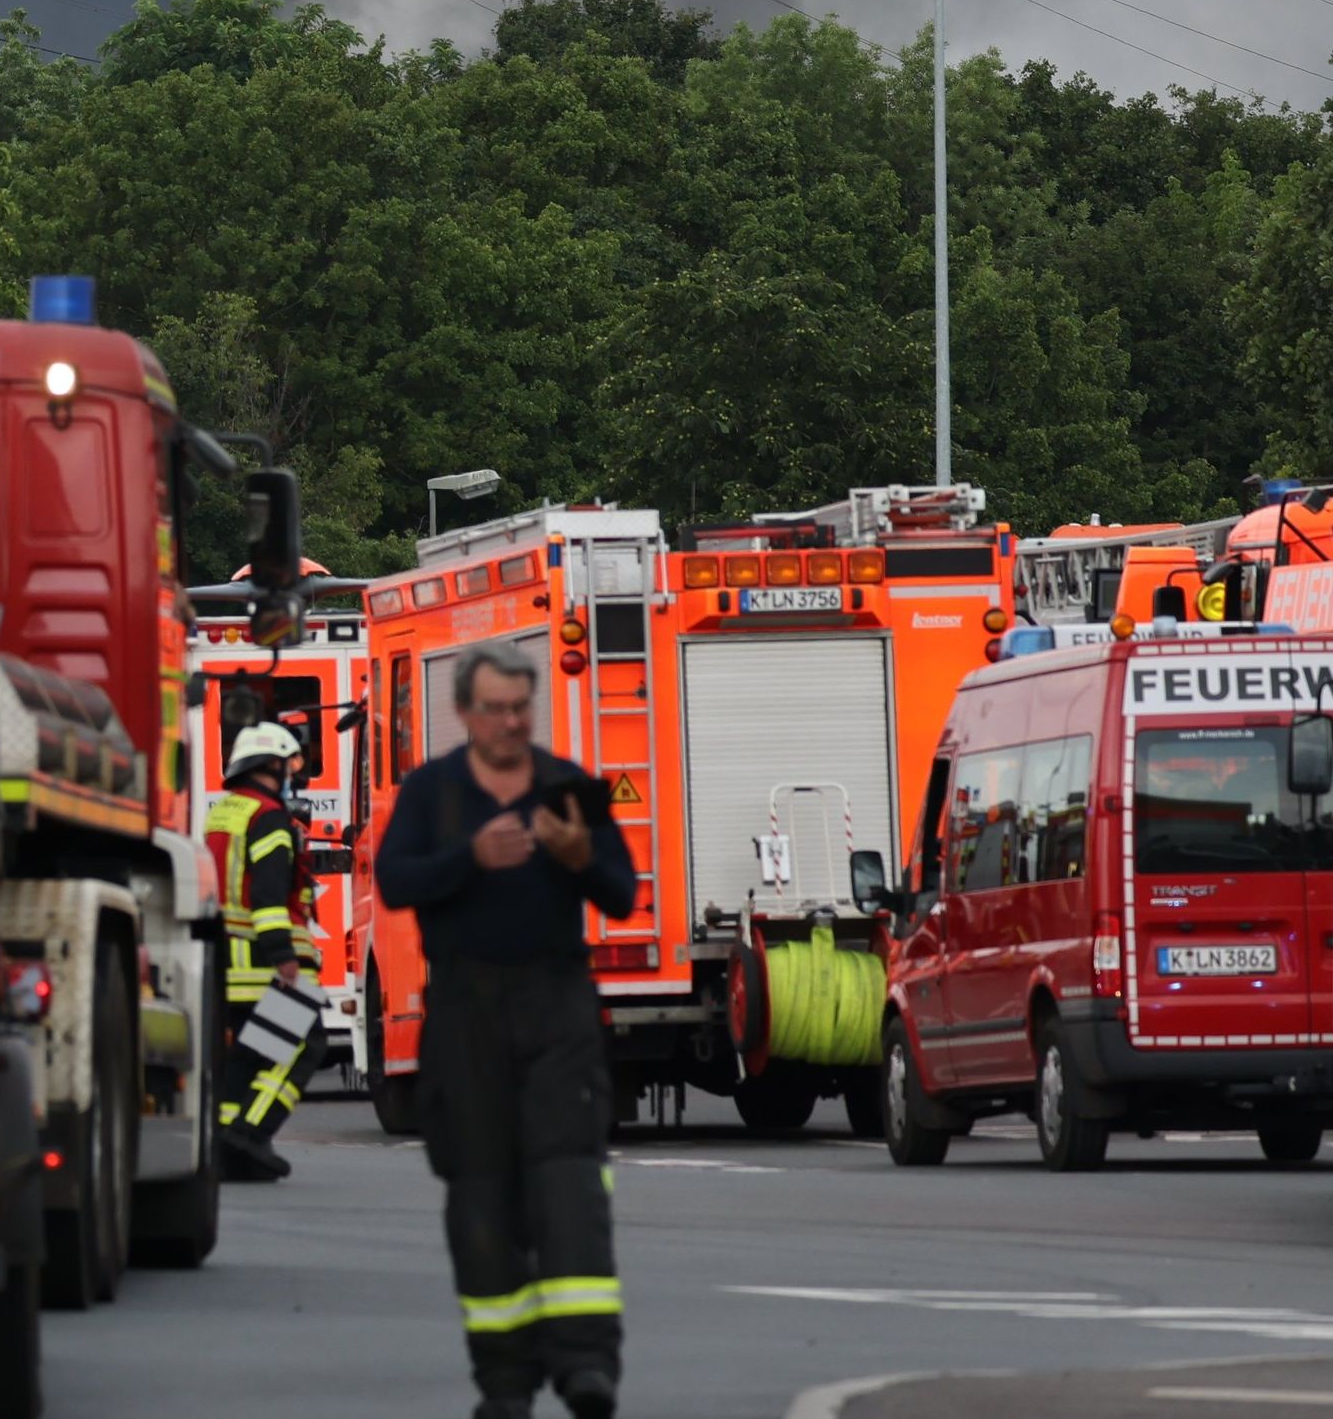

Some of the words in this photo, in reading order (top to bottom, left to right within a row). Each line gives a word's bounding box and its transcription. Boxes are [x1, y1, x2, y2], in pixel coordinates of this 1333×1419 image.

[751, 592, 761, 608] K
[772, 592, 793, 608] LN
[798, 591, 838, 607] 3756
[1171, 951, 1182, 969] K
[1196, 951, 1221, 969] LN
[1225, 950, 1272, 968] 3862
